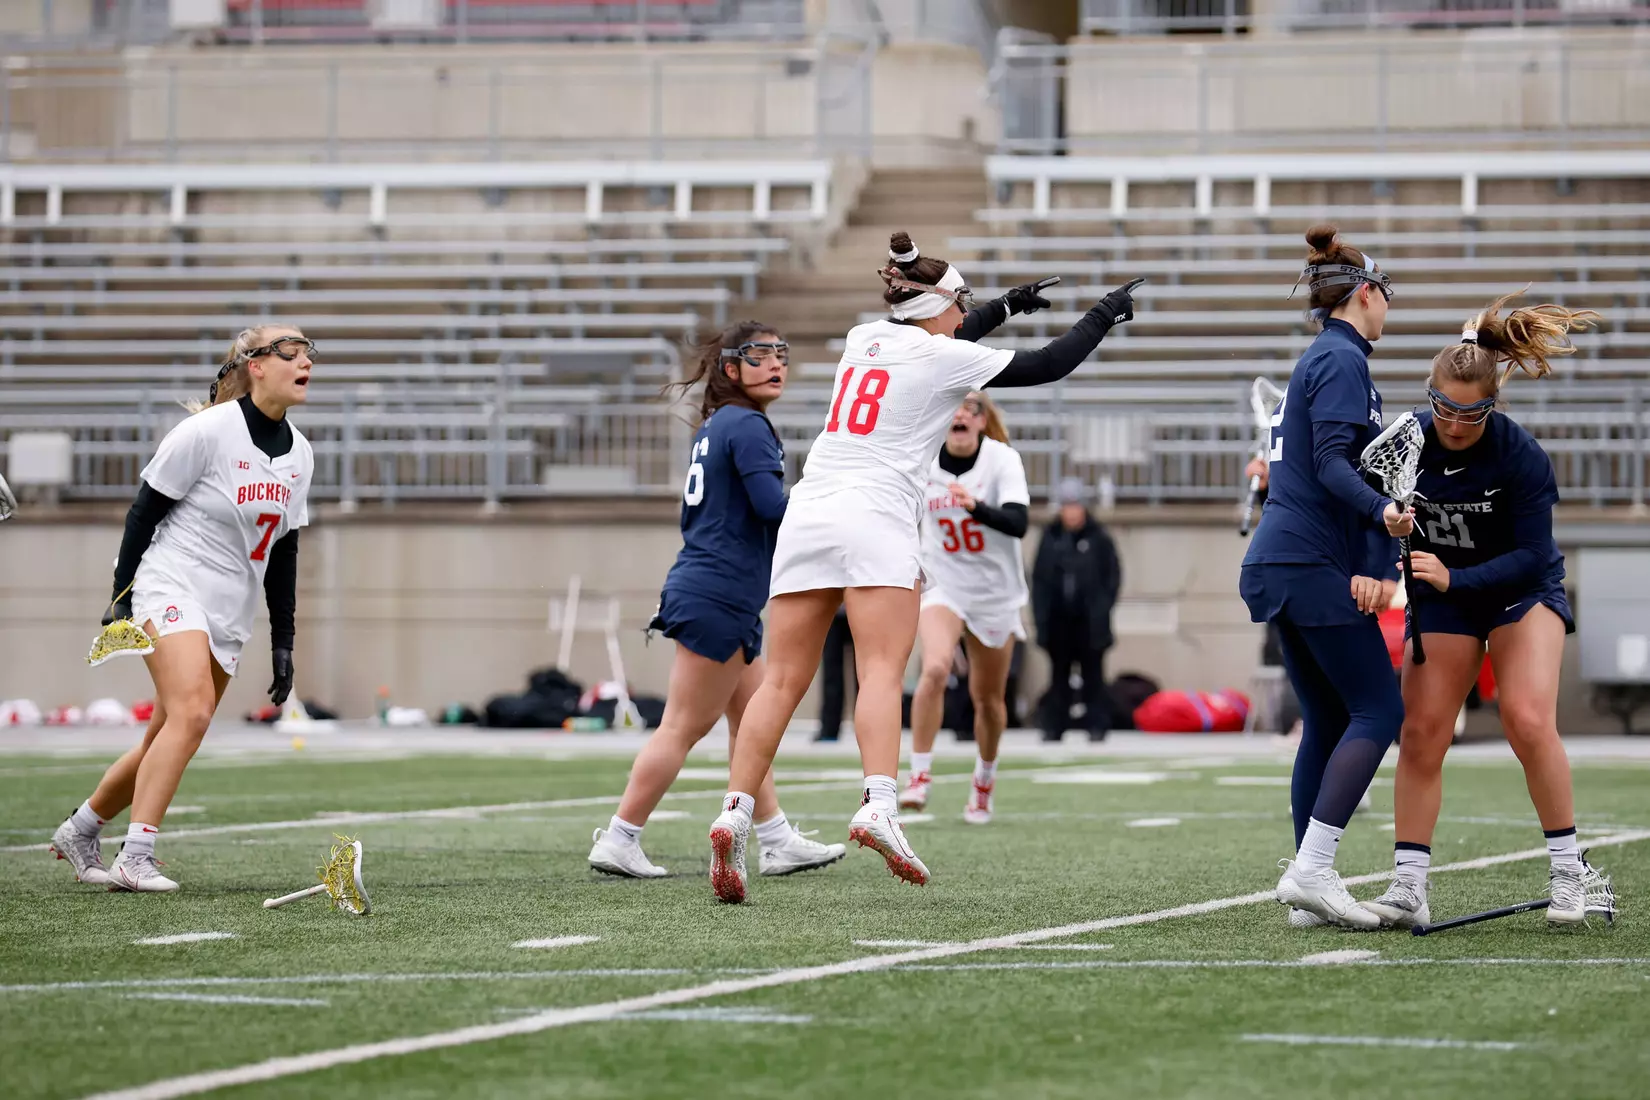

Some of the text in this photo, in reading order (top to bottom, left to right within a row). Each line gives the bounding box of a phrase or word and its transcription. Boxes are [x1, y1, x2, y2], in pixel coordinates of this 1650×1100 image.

[1340, 265, 1360, 275] STX
[826, 367, 890, 436] 18
[684, 437, 709, 506] 6
[1443, 502, 1492, 512] STATE
[250, 513, 281, 561] 7
[938, 517, 984, 553] 36
[1426, 511, 1475, 549] 21
